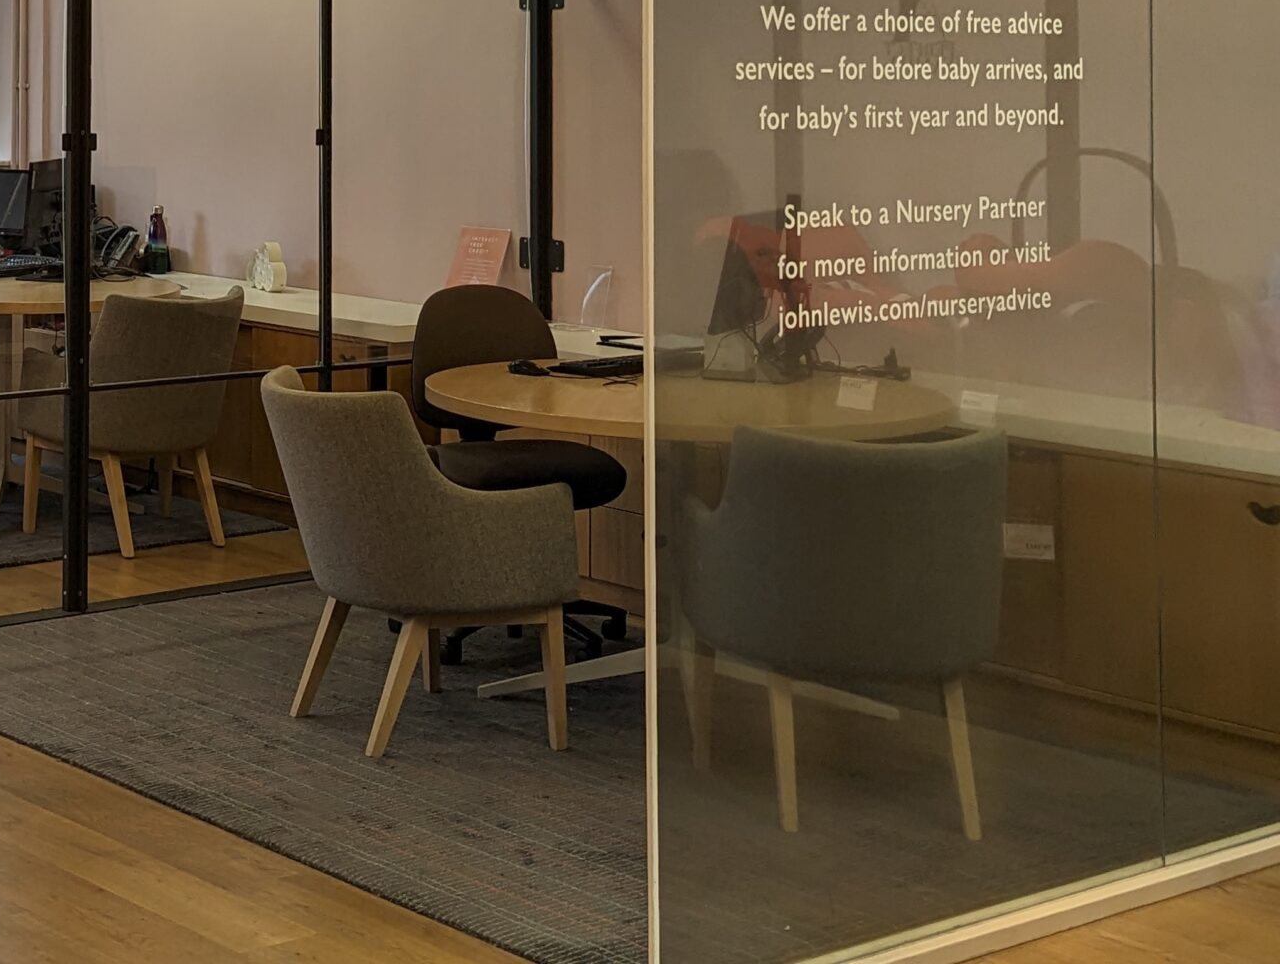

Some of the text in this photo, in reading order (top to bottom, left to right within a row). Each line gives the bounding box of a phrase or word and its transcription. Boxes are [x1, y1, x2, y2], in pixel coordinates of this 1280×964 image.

[760, 6, 1062, 34] We offer a choice of free advice
[736, 57, 814, 80] services
[839, 56, 866, 80] for
[873, 56, 931, 80] before
[939, 57, 980, 87] baby
[986, 58, 1047, 83] arrives,
[1054, 57, 1083, 79] and
[759, 105, 789, 129] for
[865, 104, 903, 128] first
[910, 111, 949, 134] year
[956, 103, 987, 126] and
[996, 103, 1063, 132] beyond.
[785, 196, 1045, 236] Speak to a Nursery Partner
[777, 241, 1051, 279] for more information or visit
[778, 289, 1052, 337] johnlewis.com/nurseryadvice
